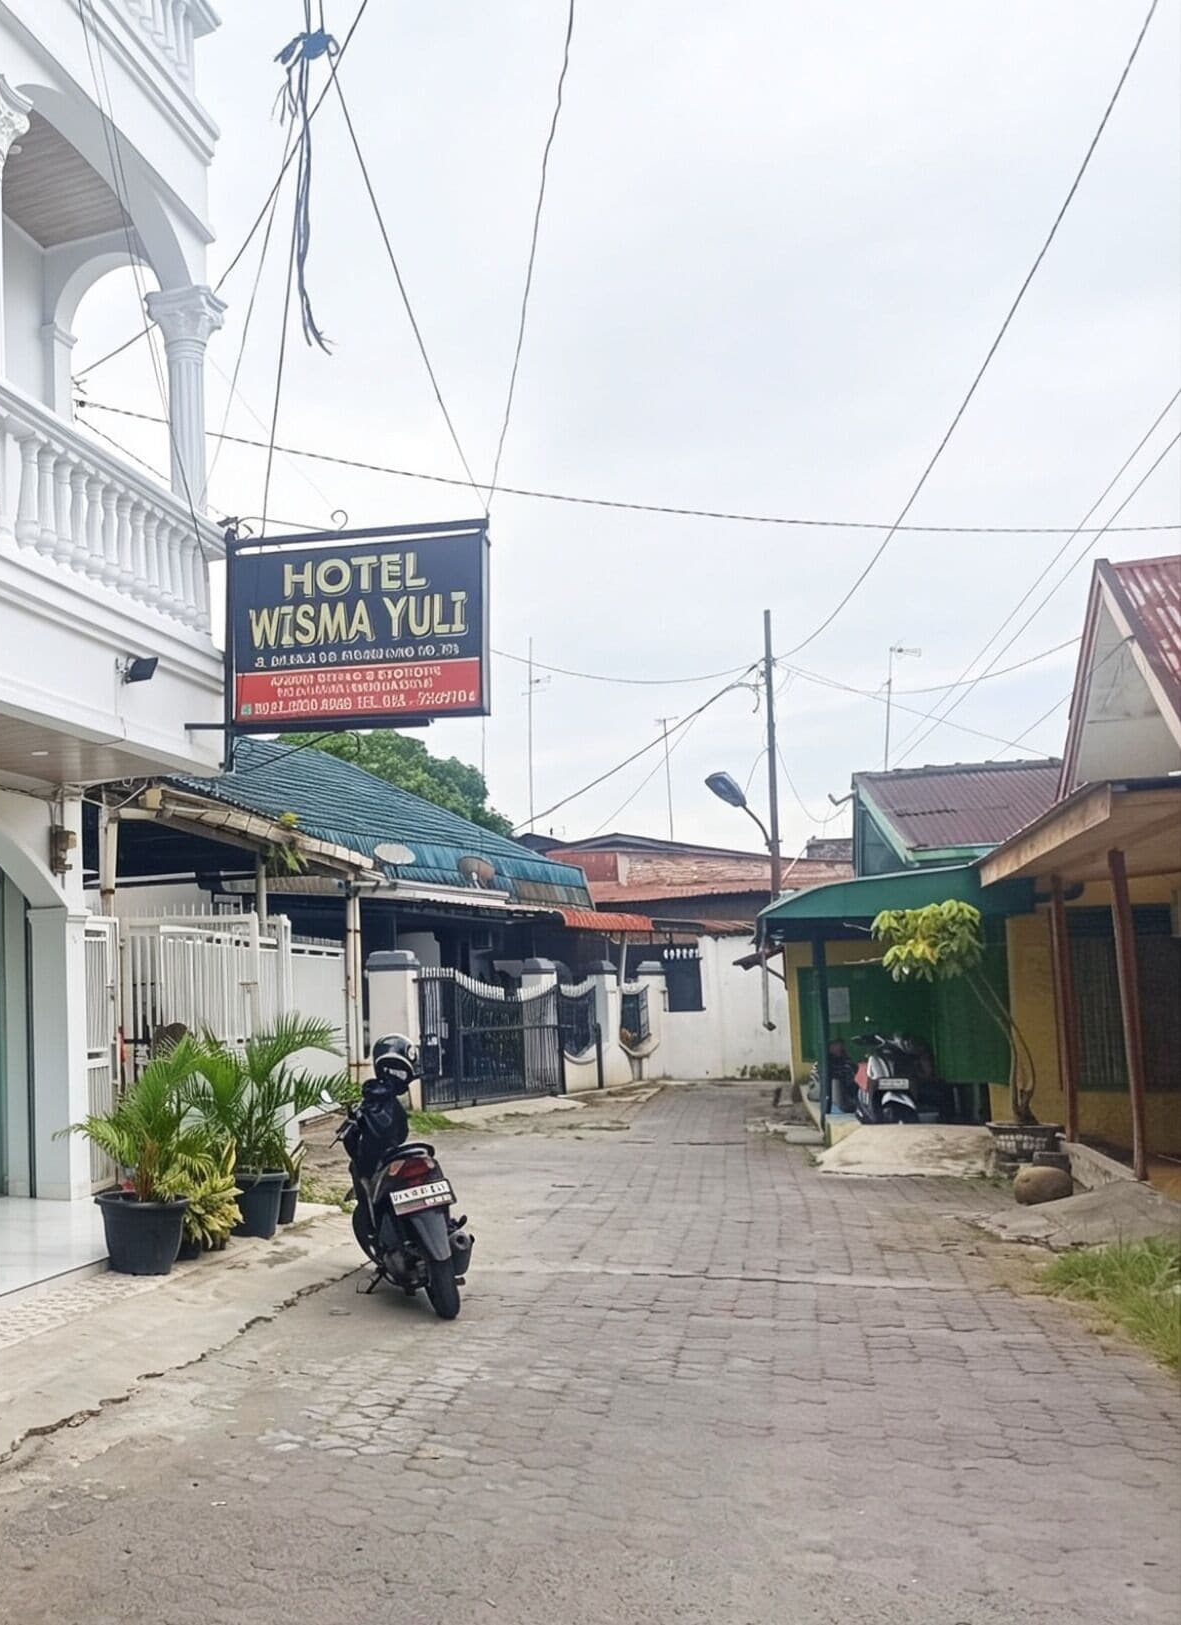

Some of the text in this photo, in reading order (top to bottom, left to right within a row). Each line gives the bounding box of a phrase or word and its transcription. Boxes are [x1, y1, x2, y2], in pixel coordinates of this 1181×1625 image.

[283, 552, 428, 597] HOTEL
[249, 591, 469, 649] WISMA YULI
